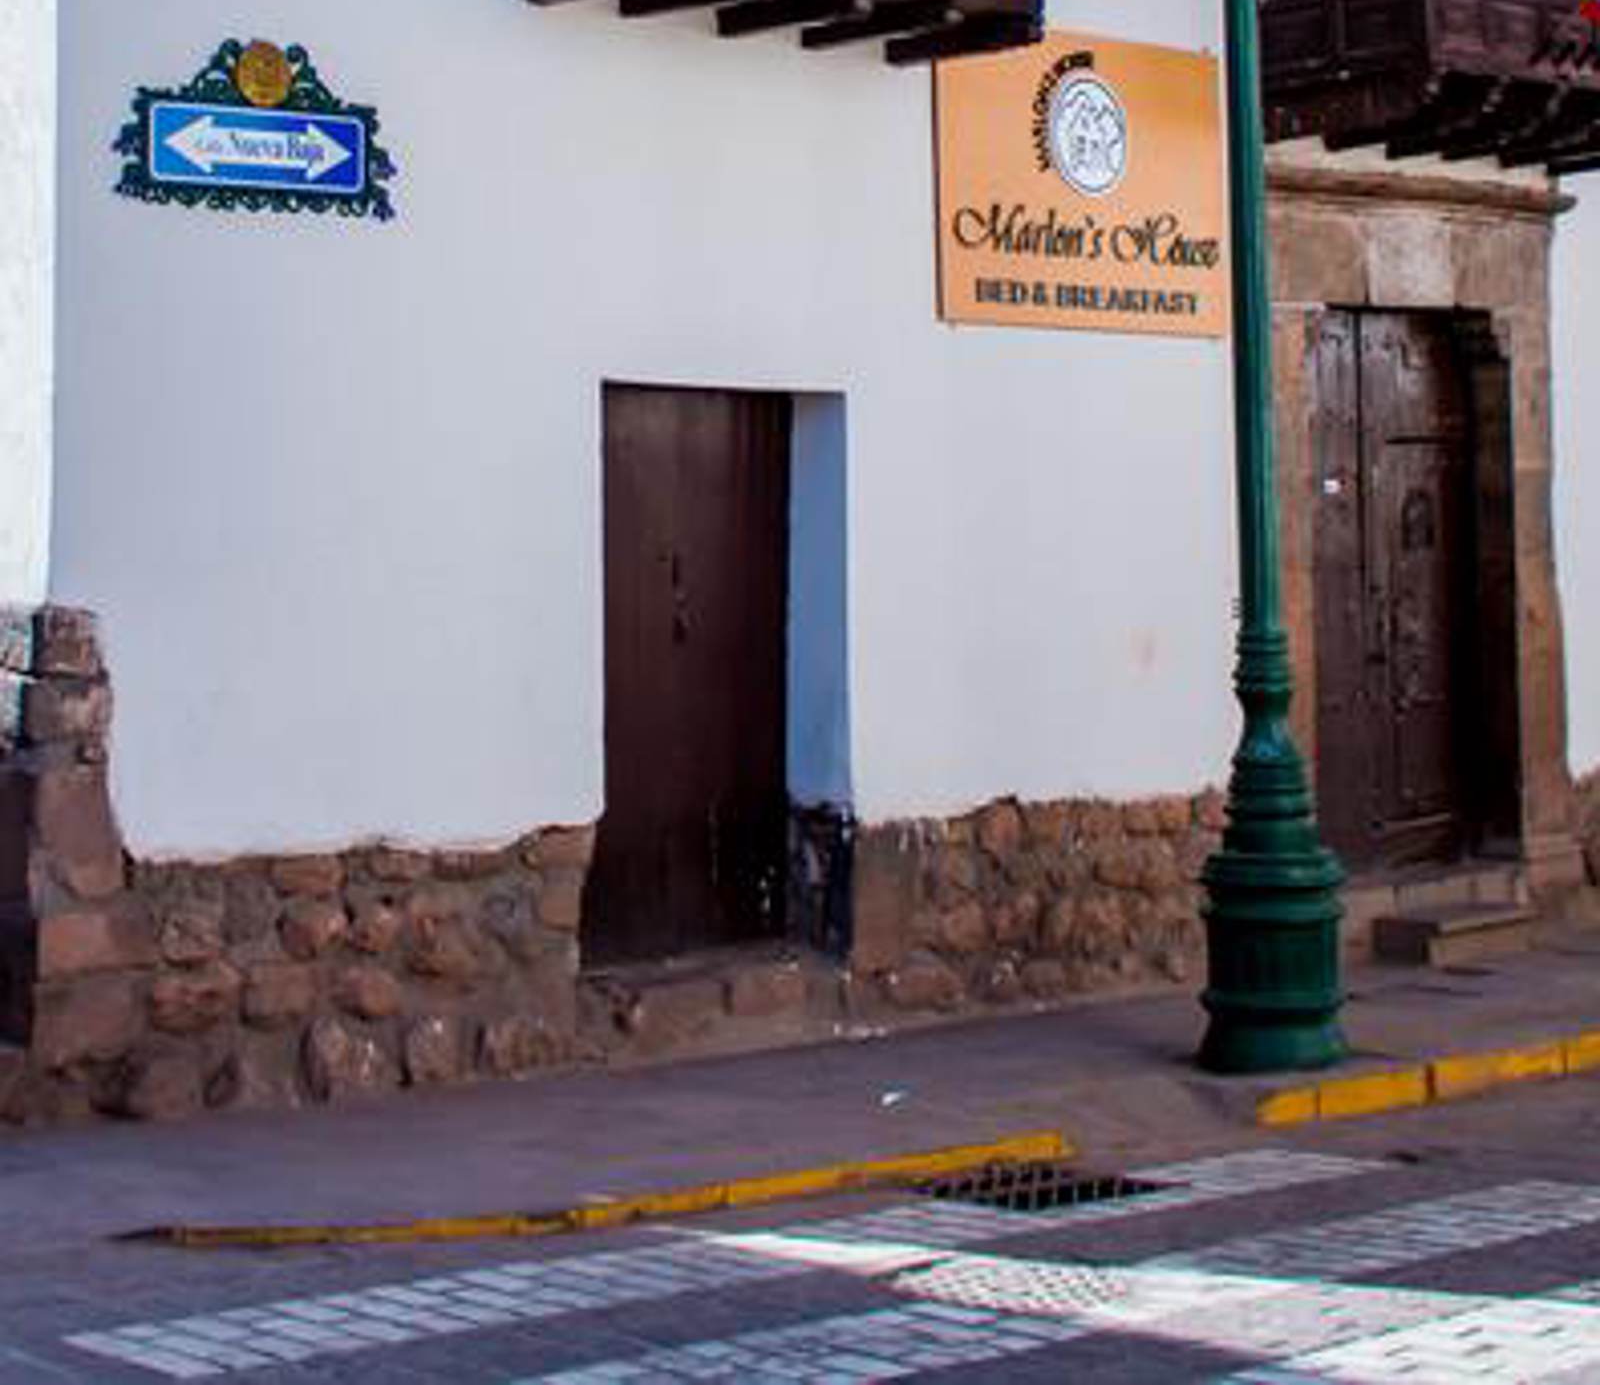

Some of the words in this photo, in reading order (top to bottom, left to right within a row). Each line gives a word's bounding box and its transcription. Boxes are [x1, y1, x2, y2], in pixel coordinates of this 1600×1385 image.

[952, 204, 1104, 259] Marlon's
[1110, 213, 1219, 269] House
[974, 278, 1029, 304] BED
[1033, 281, 1049, 305] &
[1056, 284, 1197, 314] BREAKFAST
